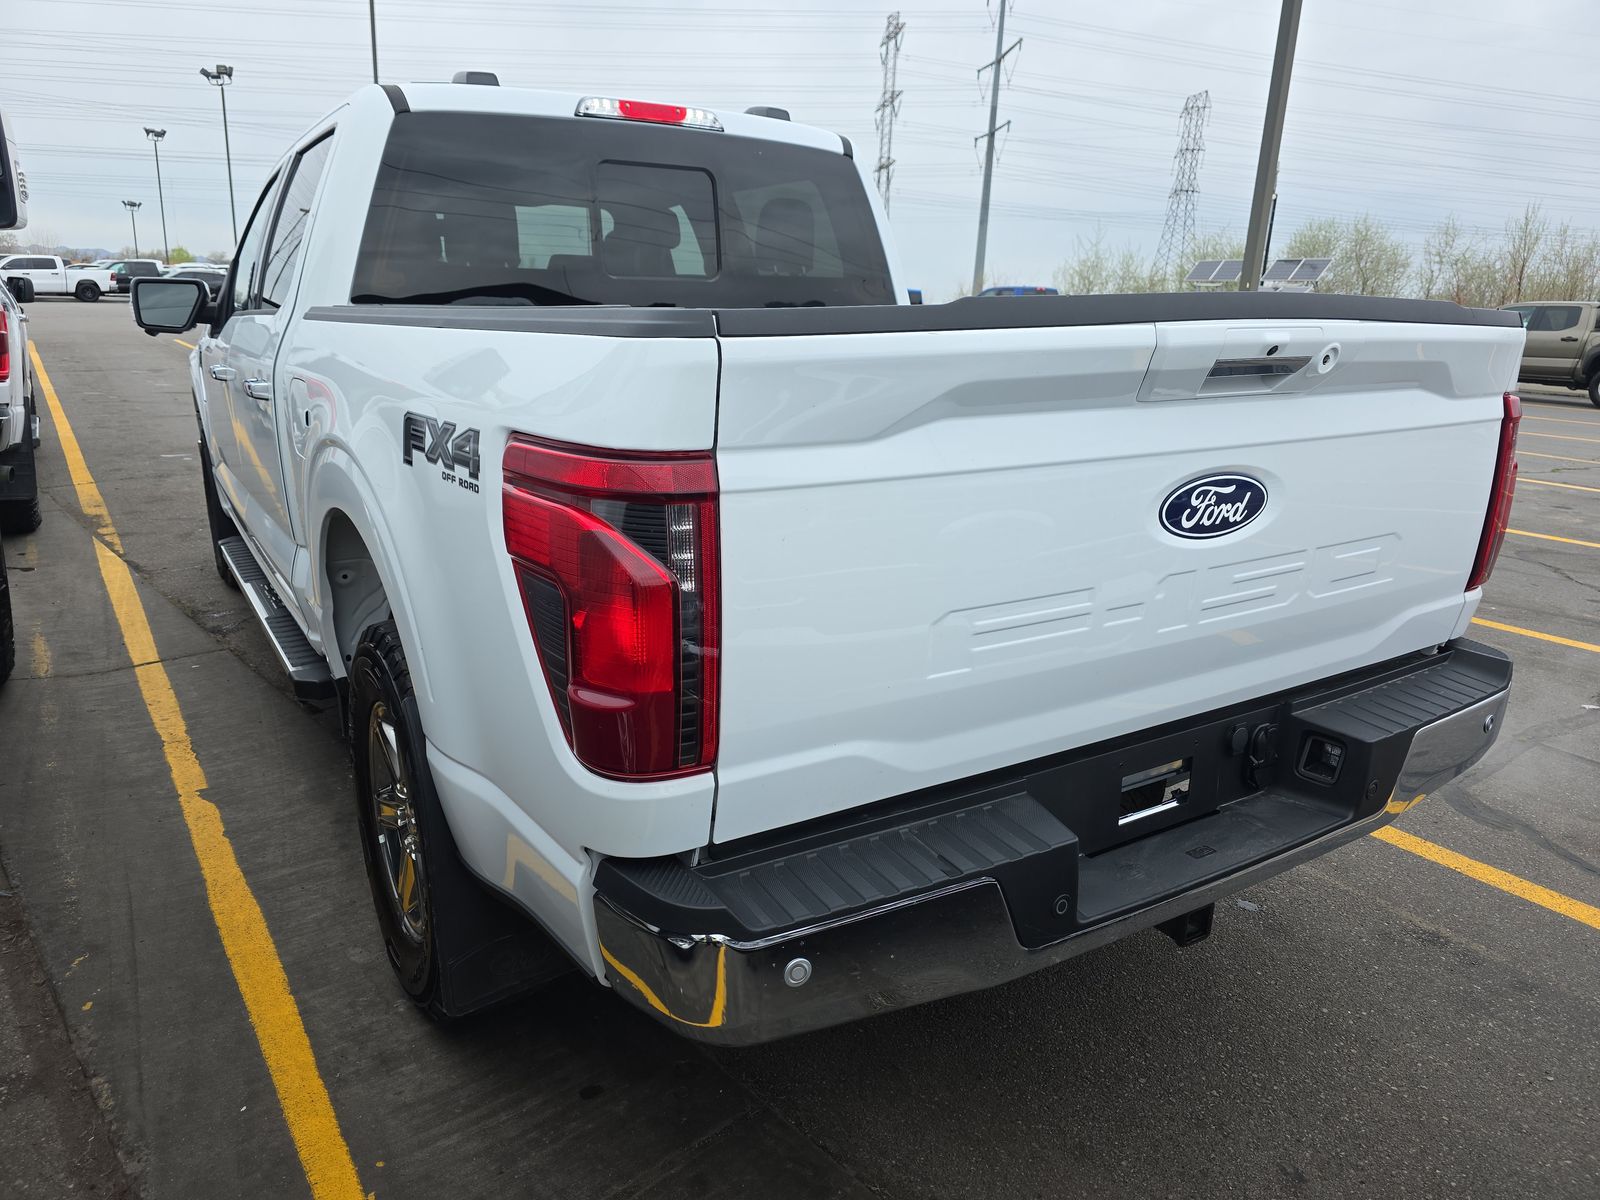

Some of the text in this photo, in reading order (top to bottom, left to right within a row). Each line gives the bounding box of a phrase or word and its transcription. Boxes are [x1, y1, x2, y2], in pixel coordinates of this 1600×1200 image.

[403, 410, 481, 482] FX4
[441, 471, 480, 494] OFF ROAD
[1181, 484, 1252, 529] Ford
